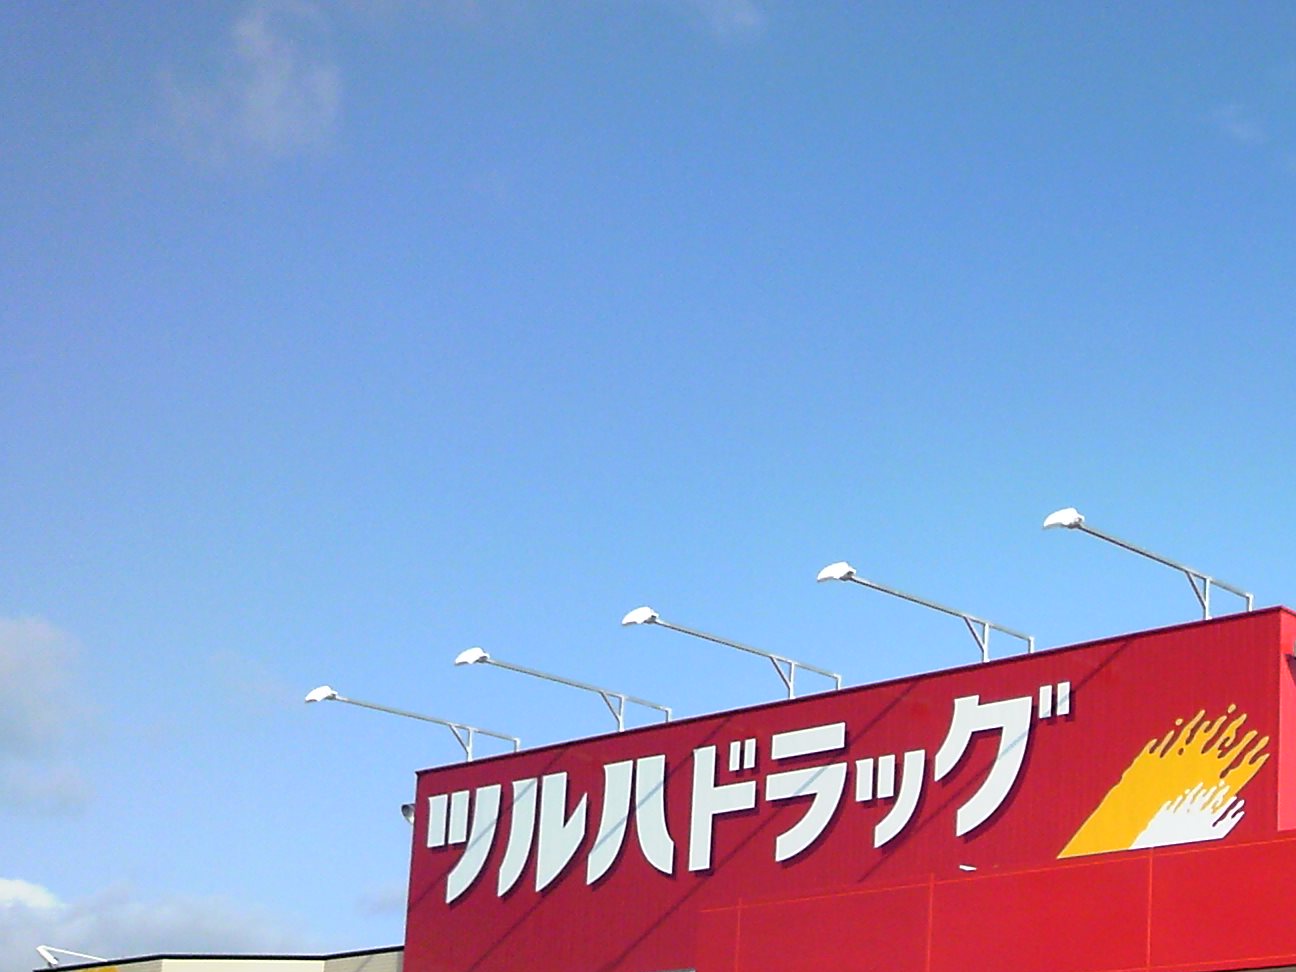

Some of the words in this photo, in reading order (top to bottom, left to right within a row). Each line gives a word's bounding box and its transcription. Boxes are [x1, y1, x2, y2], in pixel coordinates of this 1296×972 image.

[427, 681, 1071, 904] ツルハドラッグ
